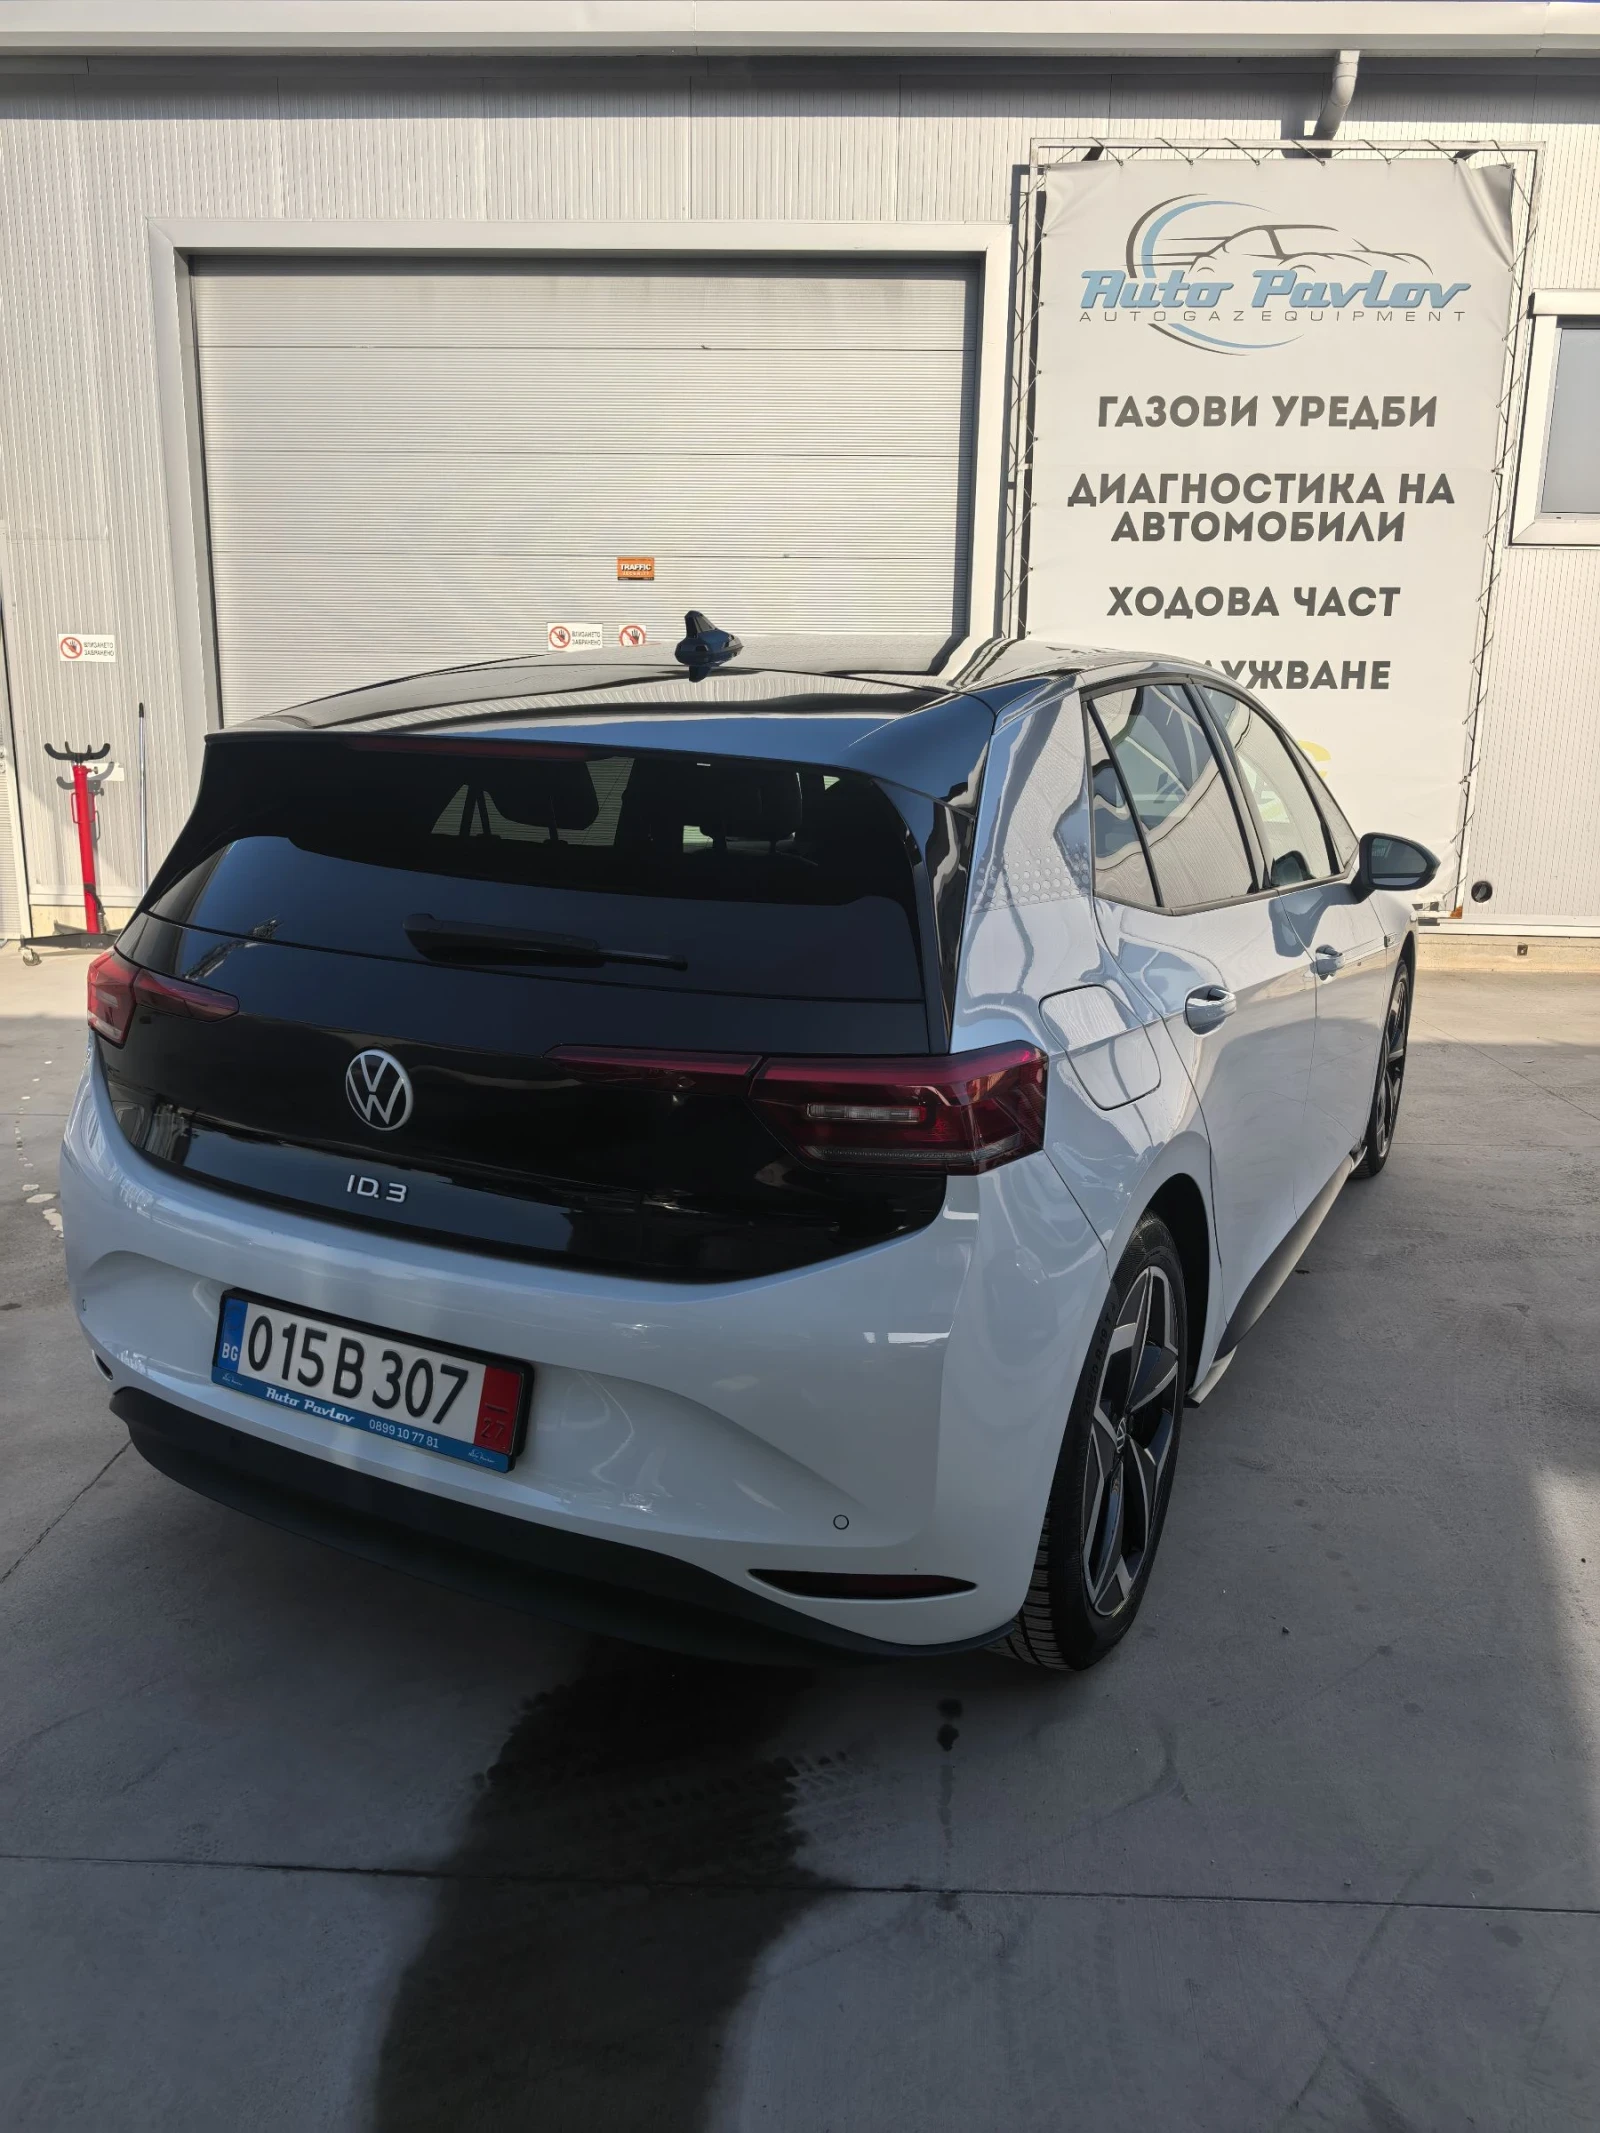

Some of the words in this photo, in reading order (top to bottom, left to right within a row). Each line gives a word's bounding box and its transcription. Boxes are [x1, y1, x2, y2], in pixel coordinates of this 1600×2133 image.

[1080, 269, 1234, 309] Auto
[1098, 396, 1259, 427] ГАЗОВИ
[1271, 396, 1437, 430] УРЕДБИ
[1067, 473, 1385, 507] ДИАГНОСТИКА
[1398, 473, 1455, 504] НА
[1110, 510, 1405, 542] АВТОМОБИЛИ
[1106, 586, 1280, 619] ХОДОВА
[1293, 586, 1401, 616] ЧАСТ
[1203, 660, 1391, 690] УЖВАНЕ
[221, 1342, 239, 1362] BG
[266, 1386, 300, 1408] Auto
[369, 1418, 396, 1436] 0899
